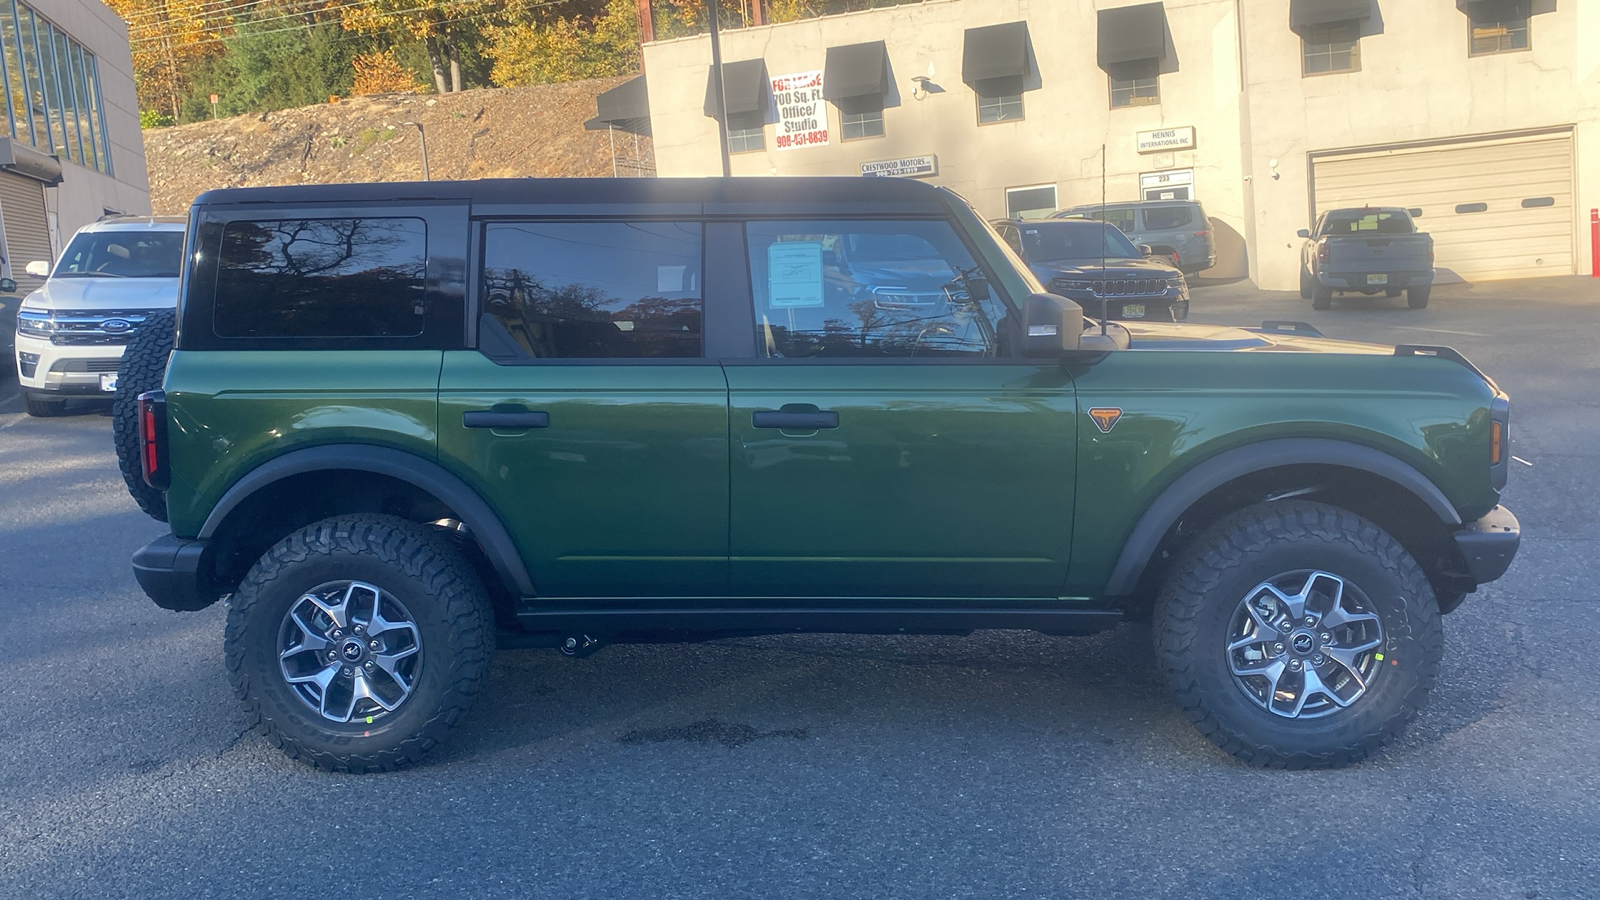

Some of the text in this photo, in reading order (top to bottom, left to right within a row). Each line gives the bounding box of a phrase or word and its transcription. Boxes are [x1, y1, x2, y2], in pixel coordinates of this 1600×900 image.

[773, 91, 792, 106] 700
[782, 102, 817, 119] Office/
[784, 118, 818, 133] Studio
[1152, 130, 1176, 140] HENNIS
[1140, 139, 1179, 149] INTERNATIONAL
[861, 161, 898, 173] CRESTWOOD
[900, 157, 925, 167] MOTORS
[1159, 174, 1170, 183] 233
